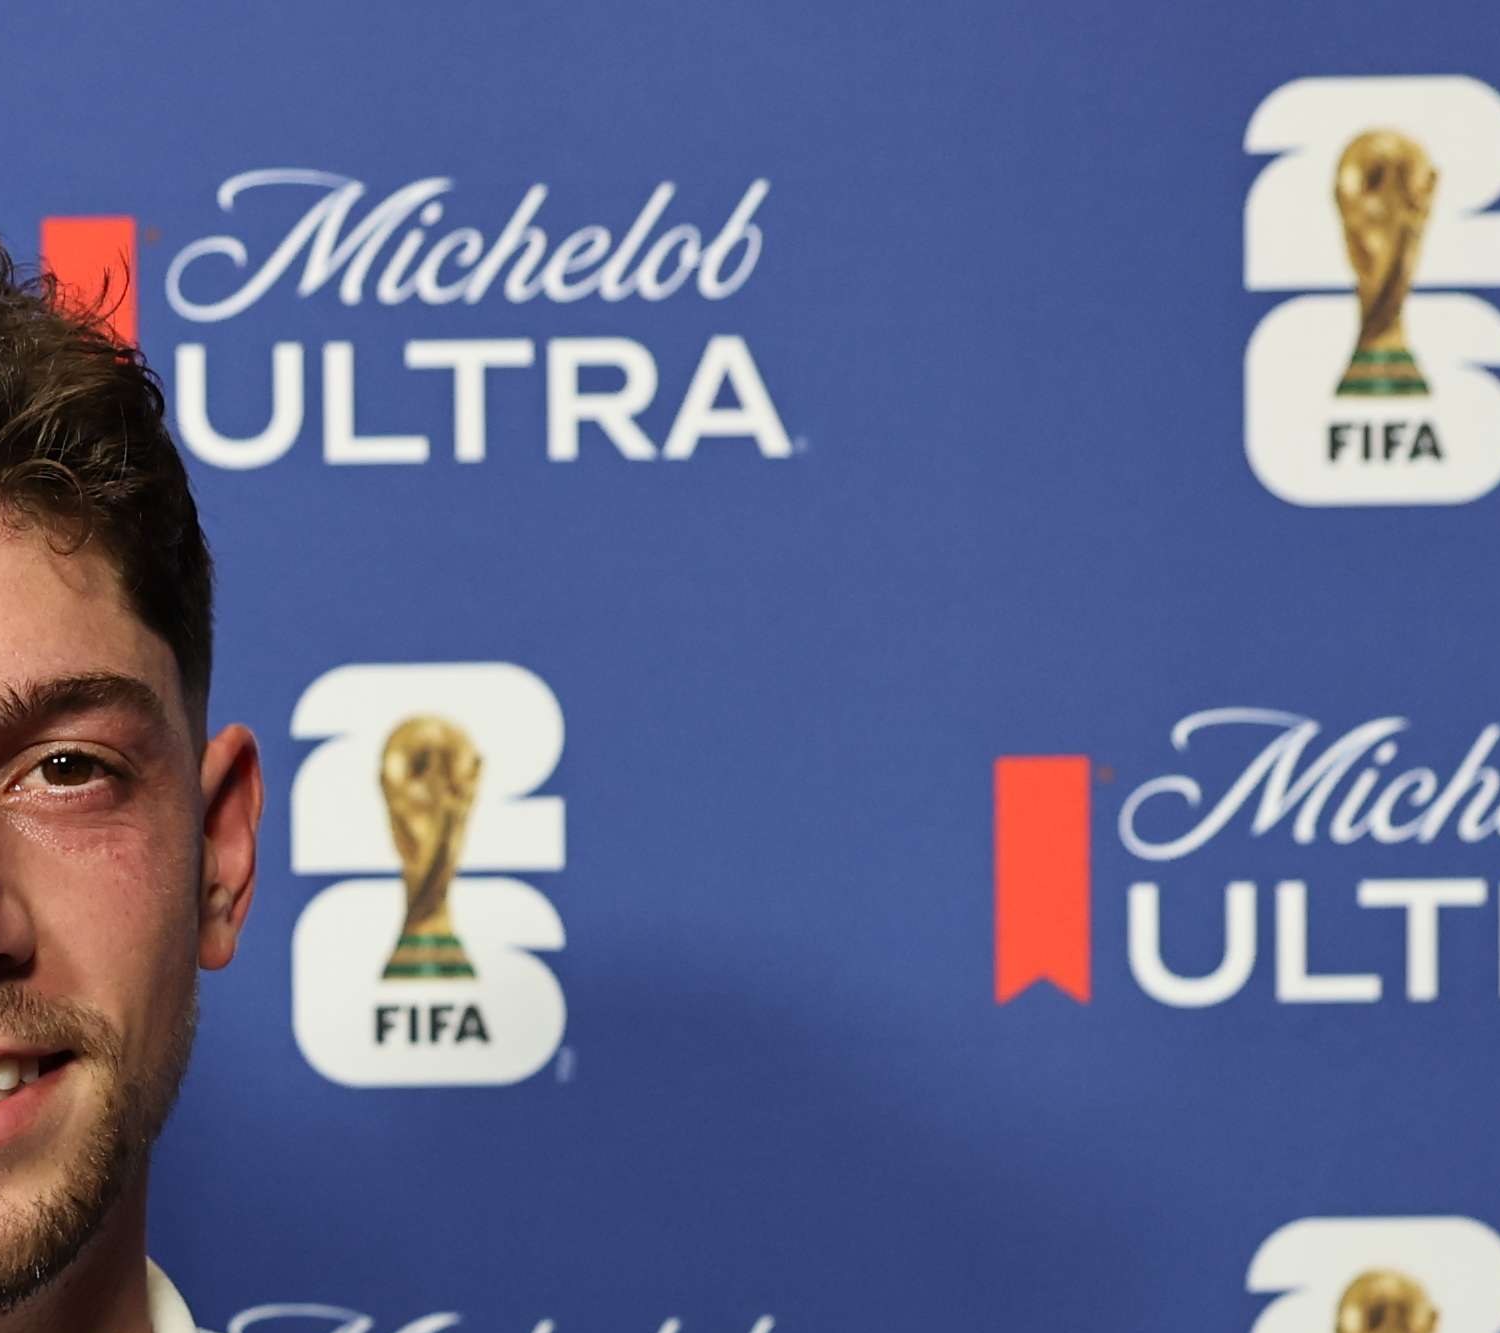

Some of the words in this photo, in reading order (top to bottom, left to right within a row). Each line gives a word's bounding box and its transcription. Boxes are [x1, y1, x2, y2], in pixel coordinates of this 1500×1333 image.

[166, 169, 769, 322] Michelob
[176, 336, 791, 469] ULTRA
[1328, 422, 1442, 462] FIFA
[376, 1005, 490, 1044] FIFA
